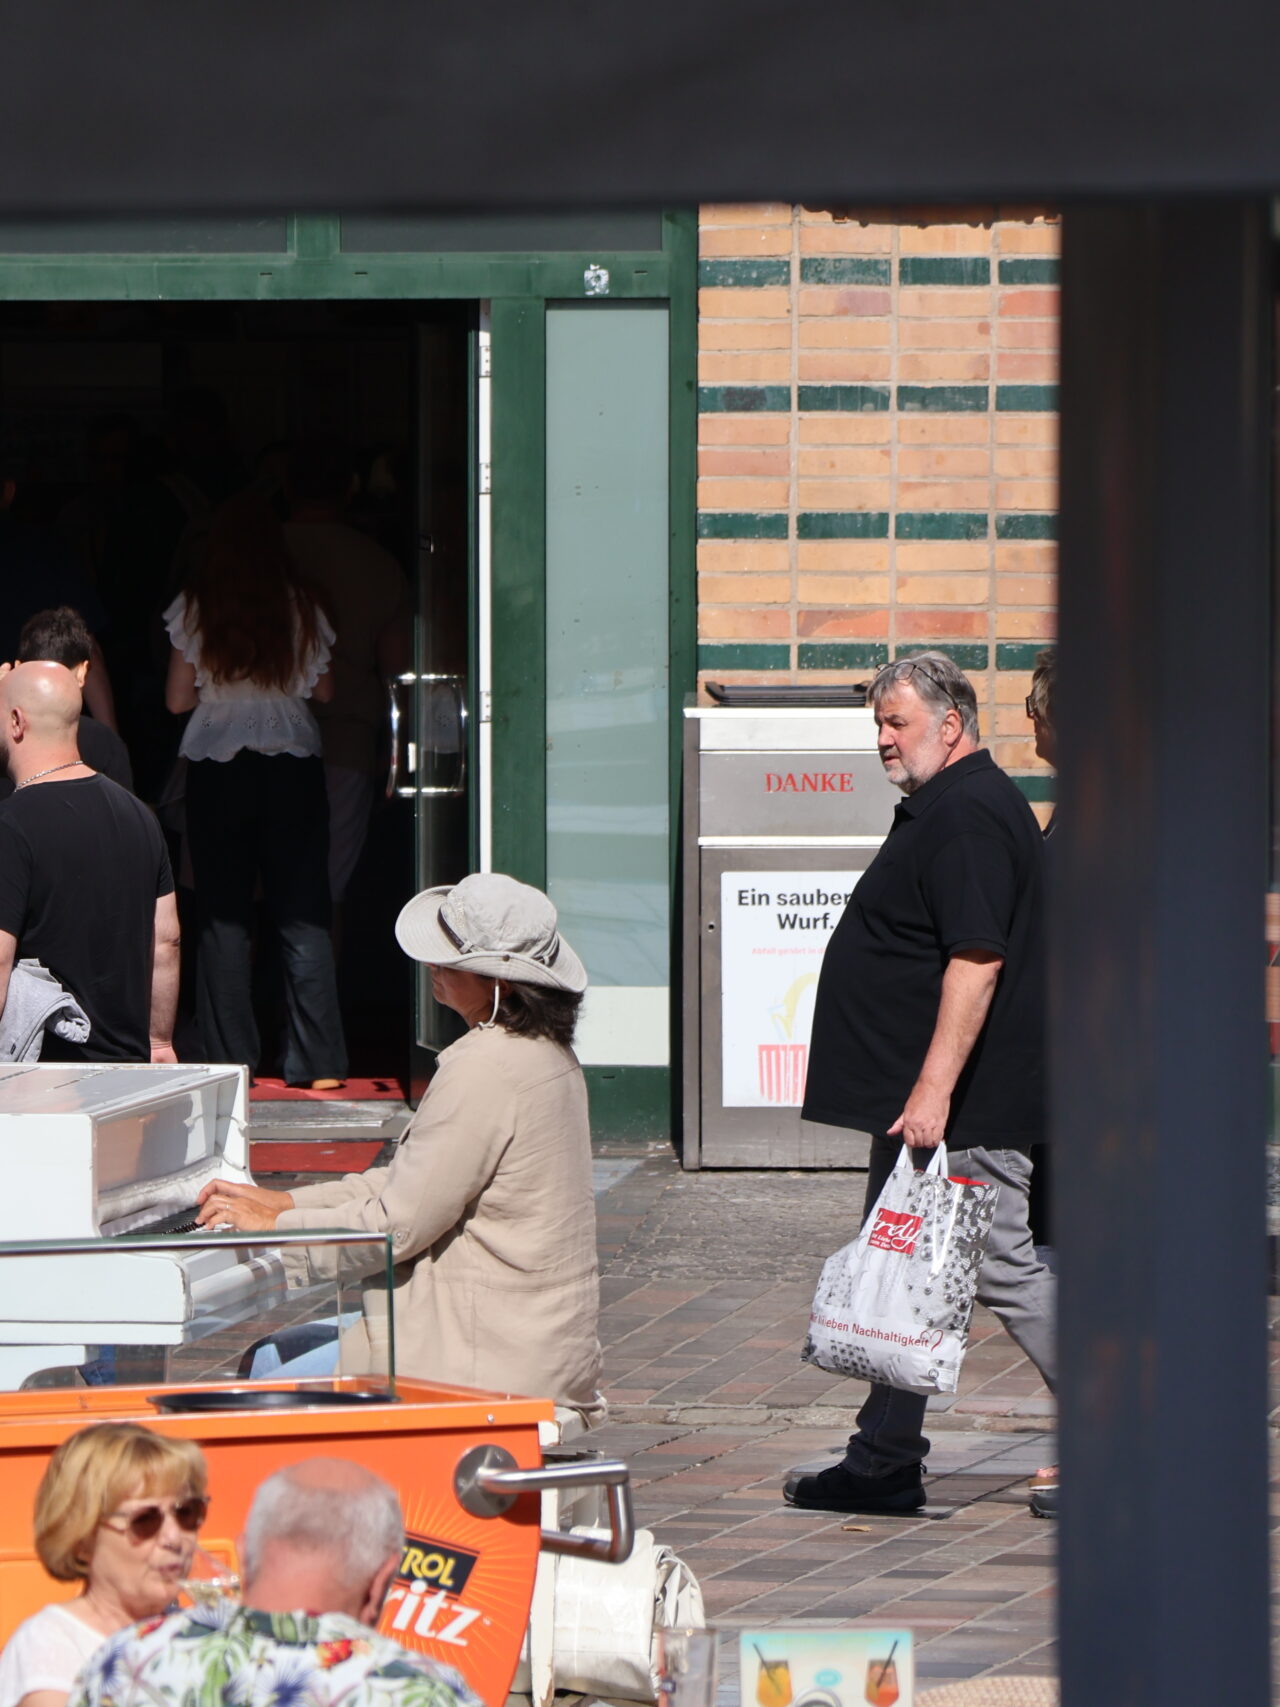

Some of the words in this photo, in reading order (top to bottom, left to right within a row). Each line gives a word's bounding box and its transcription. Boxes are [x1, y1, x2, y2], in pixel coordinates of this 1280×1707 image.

[764, 772, 854, 793] DANKE
[737, 888, 770, 906] Ein
[776, 912, 834, 930] Wurf.
[851, 1322, 929, 1348] Nachhaltigkeit
